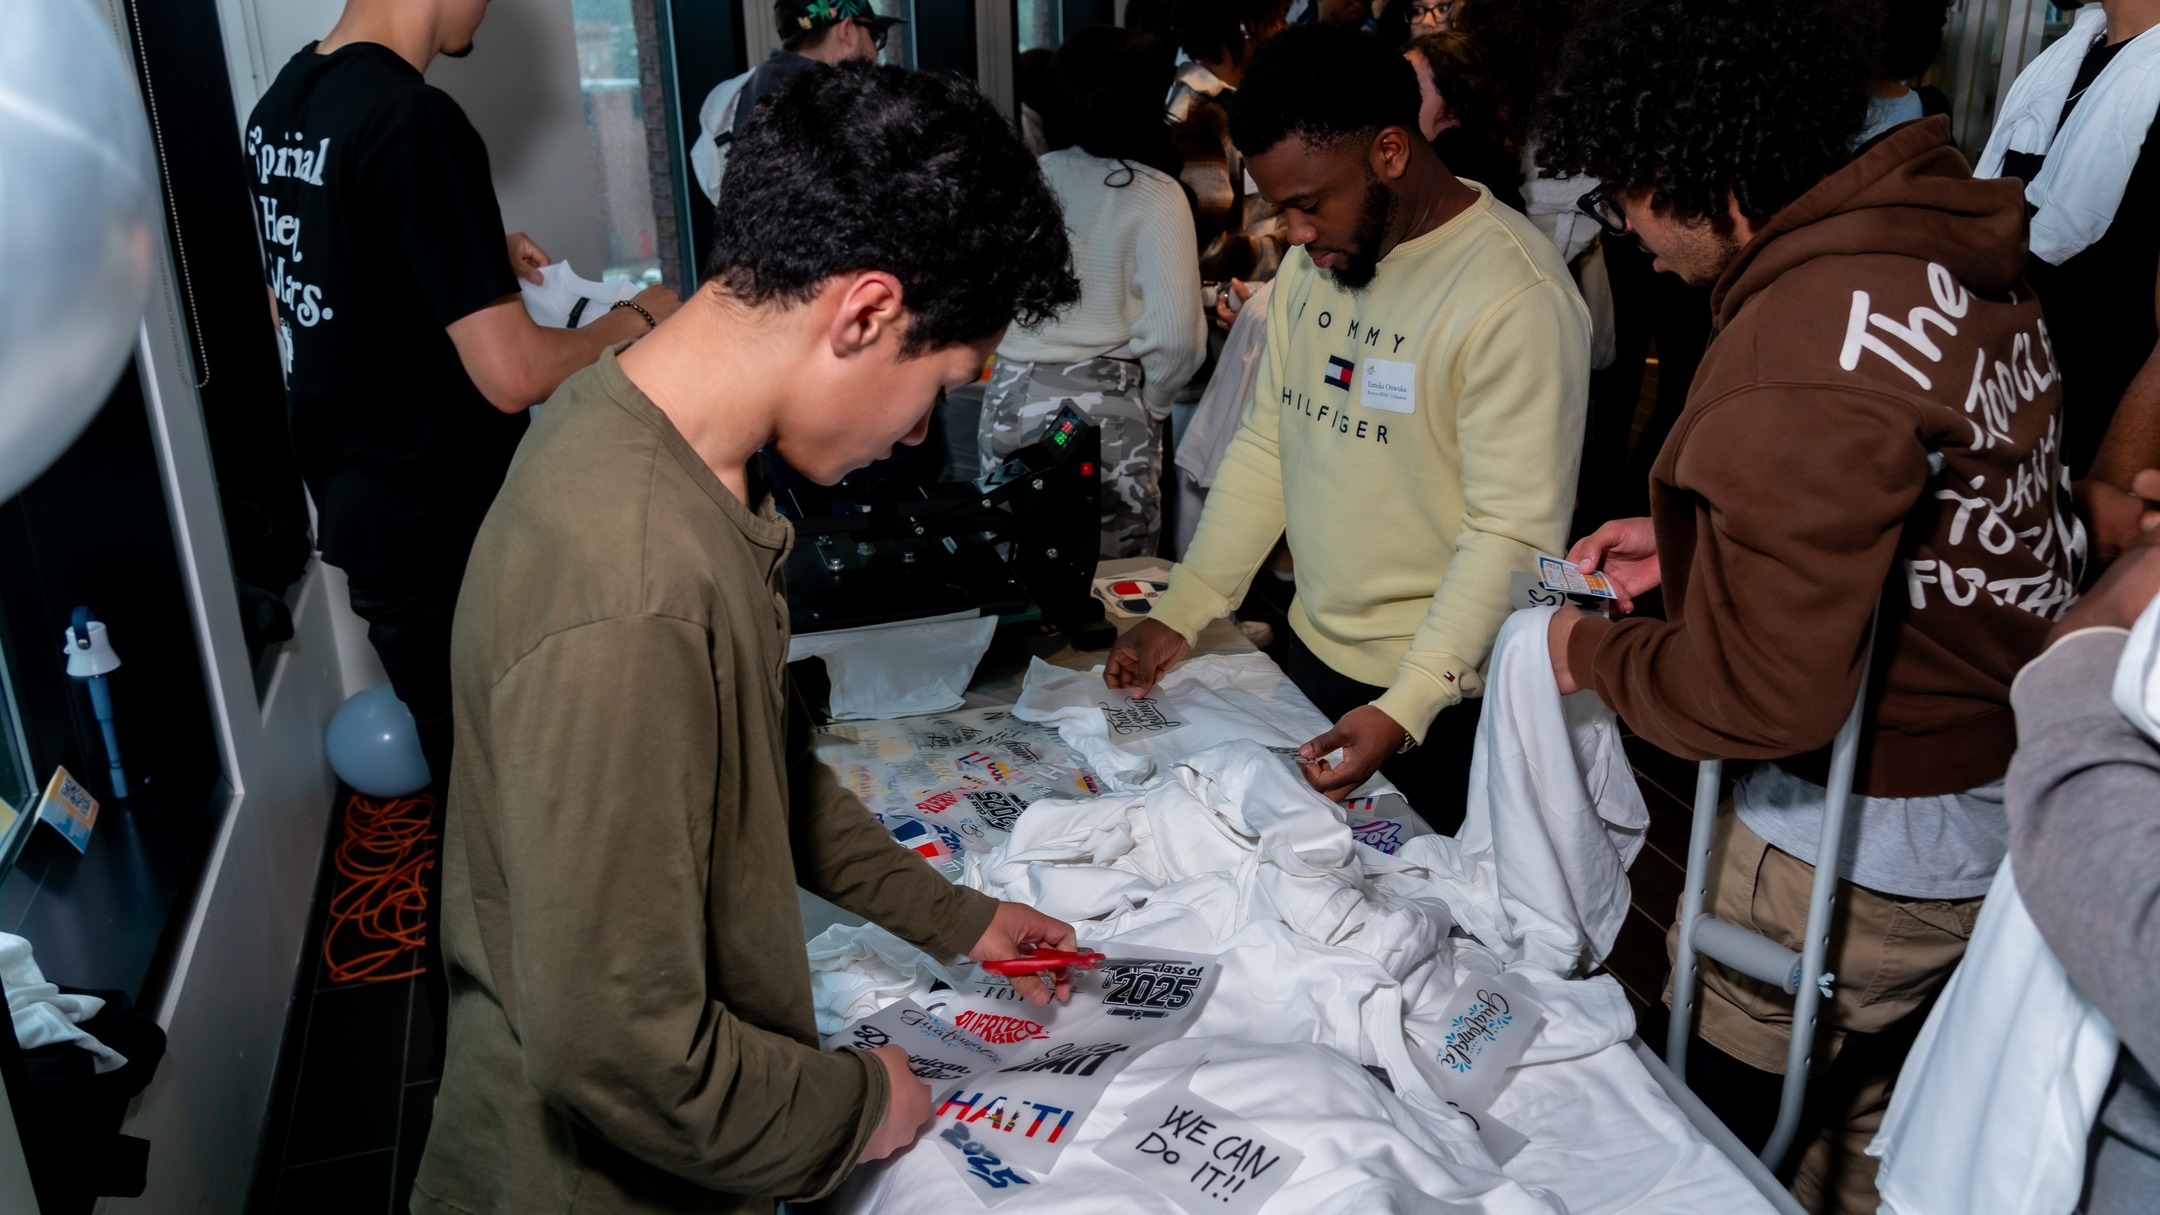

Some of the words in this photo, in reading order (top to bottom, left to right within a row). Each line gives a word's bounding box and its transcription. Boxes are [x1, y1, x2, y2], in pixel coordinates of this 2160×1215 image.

[1839, 262, 1968, 391] The
[1281, 386, 1389, 445] HILFIGER
[1102, 972, 1202, 1011] 2025
[1152, 963, 1185, 976] class
[1187, 966, 1205, 977] of
[939, 1121, 1031, 1189] 2025
[1159, 1105, 1217, 1146] WE
[1213, 1136, 1281, 1179] CAN
[1190, 1161, 1246, 1203] IT!!
